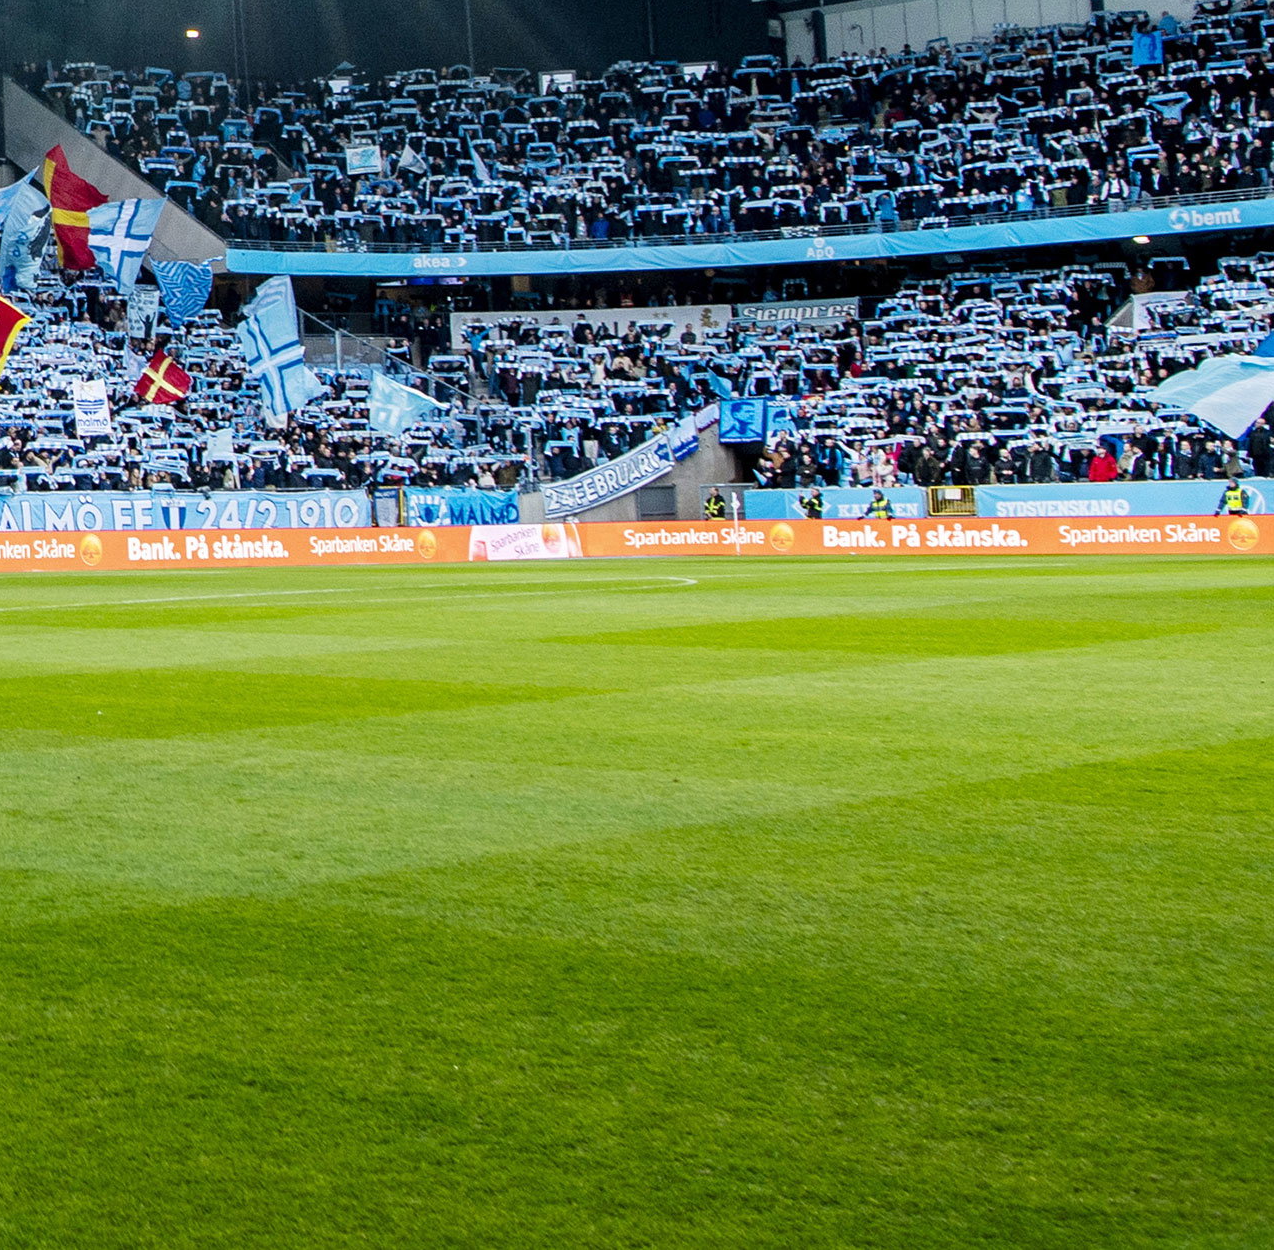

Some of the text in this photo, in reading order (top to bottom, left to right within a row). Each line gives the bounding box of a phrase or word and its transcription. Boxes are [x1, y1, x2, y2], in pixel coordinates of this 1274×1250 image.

[1191, 207, 1241, 227] bemt
[413, 253, 451, 269] akea
[806, 244, 835, 261] ApQ
[111, 500, 154, 531] FF
[196, 498, 278, 529] 24/2
[287, 497, 359, 528] 1910
[996, 500, 1112, 517] SYDSVENSKAN
[33, 538, 76, 560] Skåne
[128, 538, 181, 561] Bank.
[186, 534, 209, 560] På
[212, 534, 289, 559] skånska.
[309, 535, 378, 556] Sparbanken
[379, 533, 414, 552] Skåne
[489, 526, 538, 553] Sparbanken
[624, 523, 1221, 549] Sparbanken Skåne Bank. På skånska. Sparbanken Skåne
